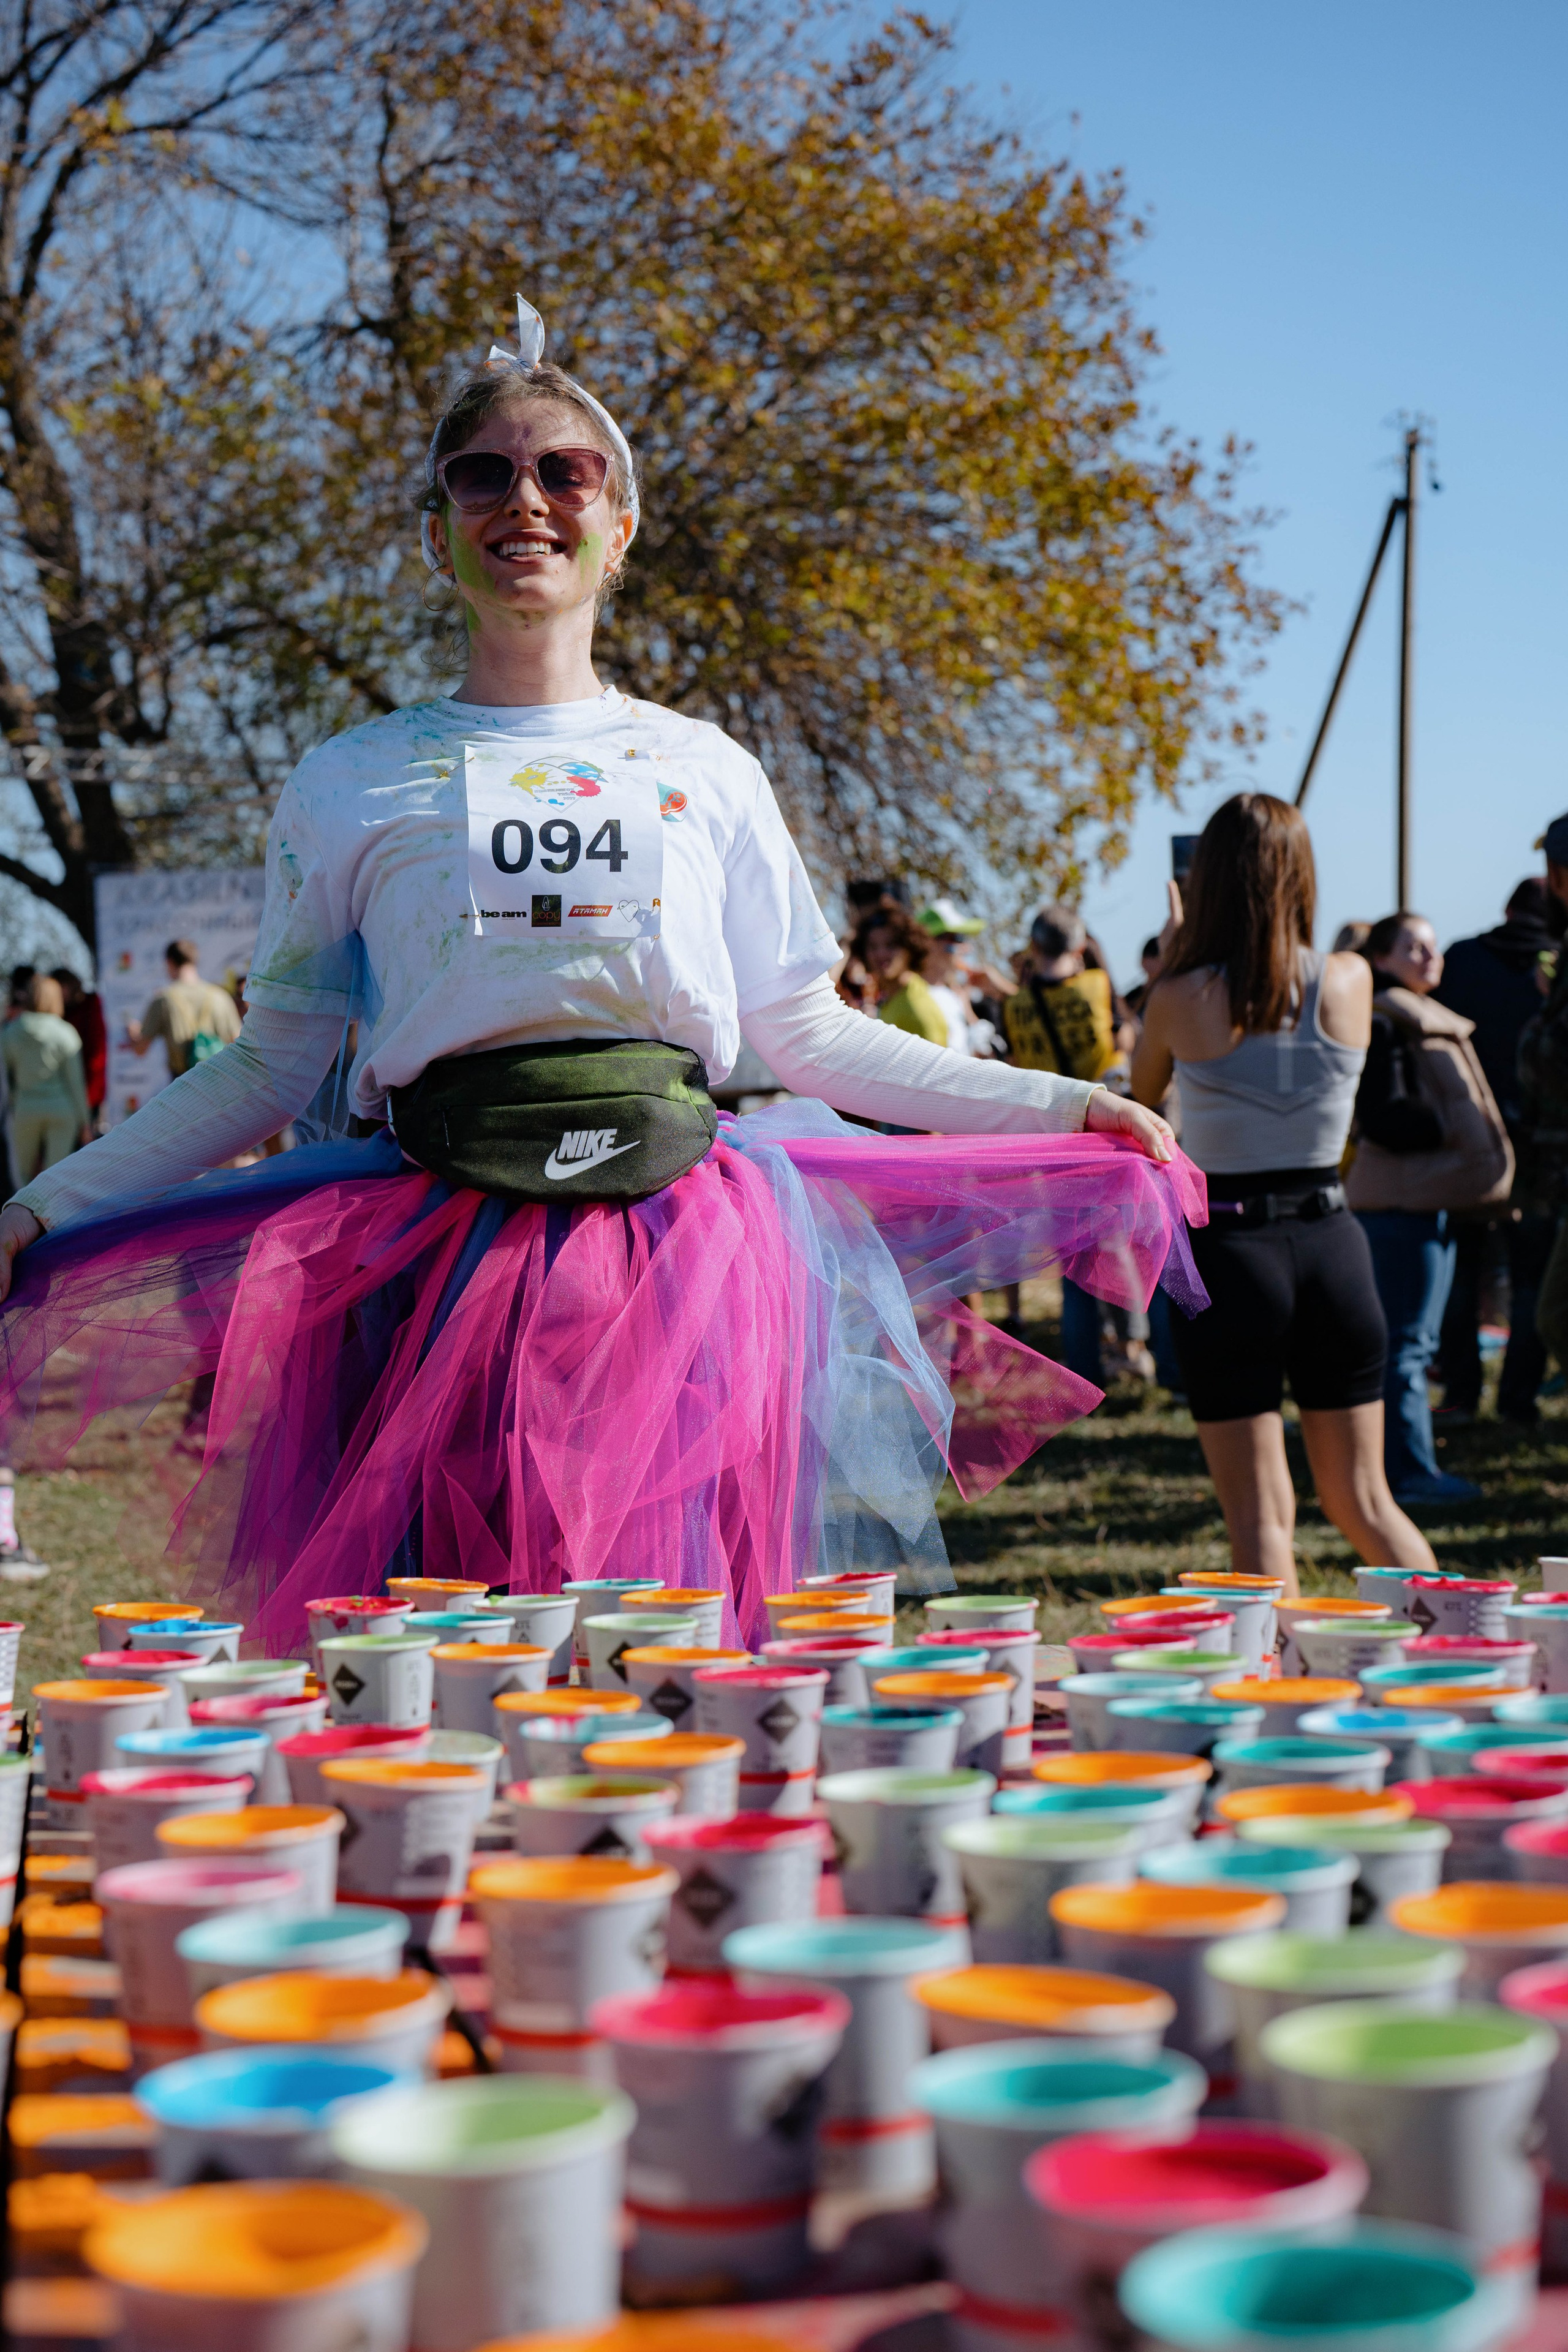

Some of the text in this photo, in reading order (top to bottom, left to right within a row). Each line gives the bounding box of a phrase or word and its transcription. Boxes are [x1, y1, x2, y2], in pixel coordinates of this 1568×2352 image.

[491, 819, 628, 874] 094
[532, 911, 560, 921] copy
[557, 1128, 617, 1159] NIKE
